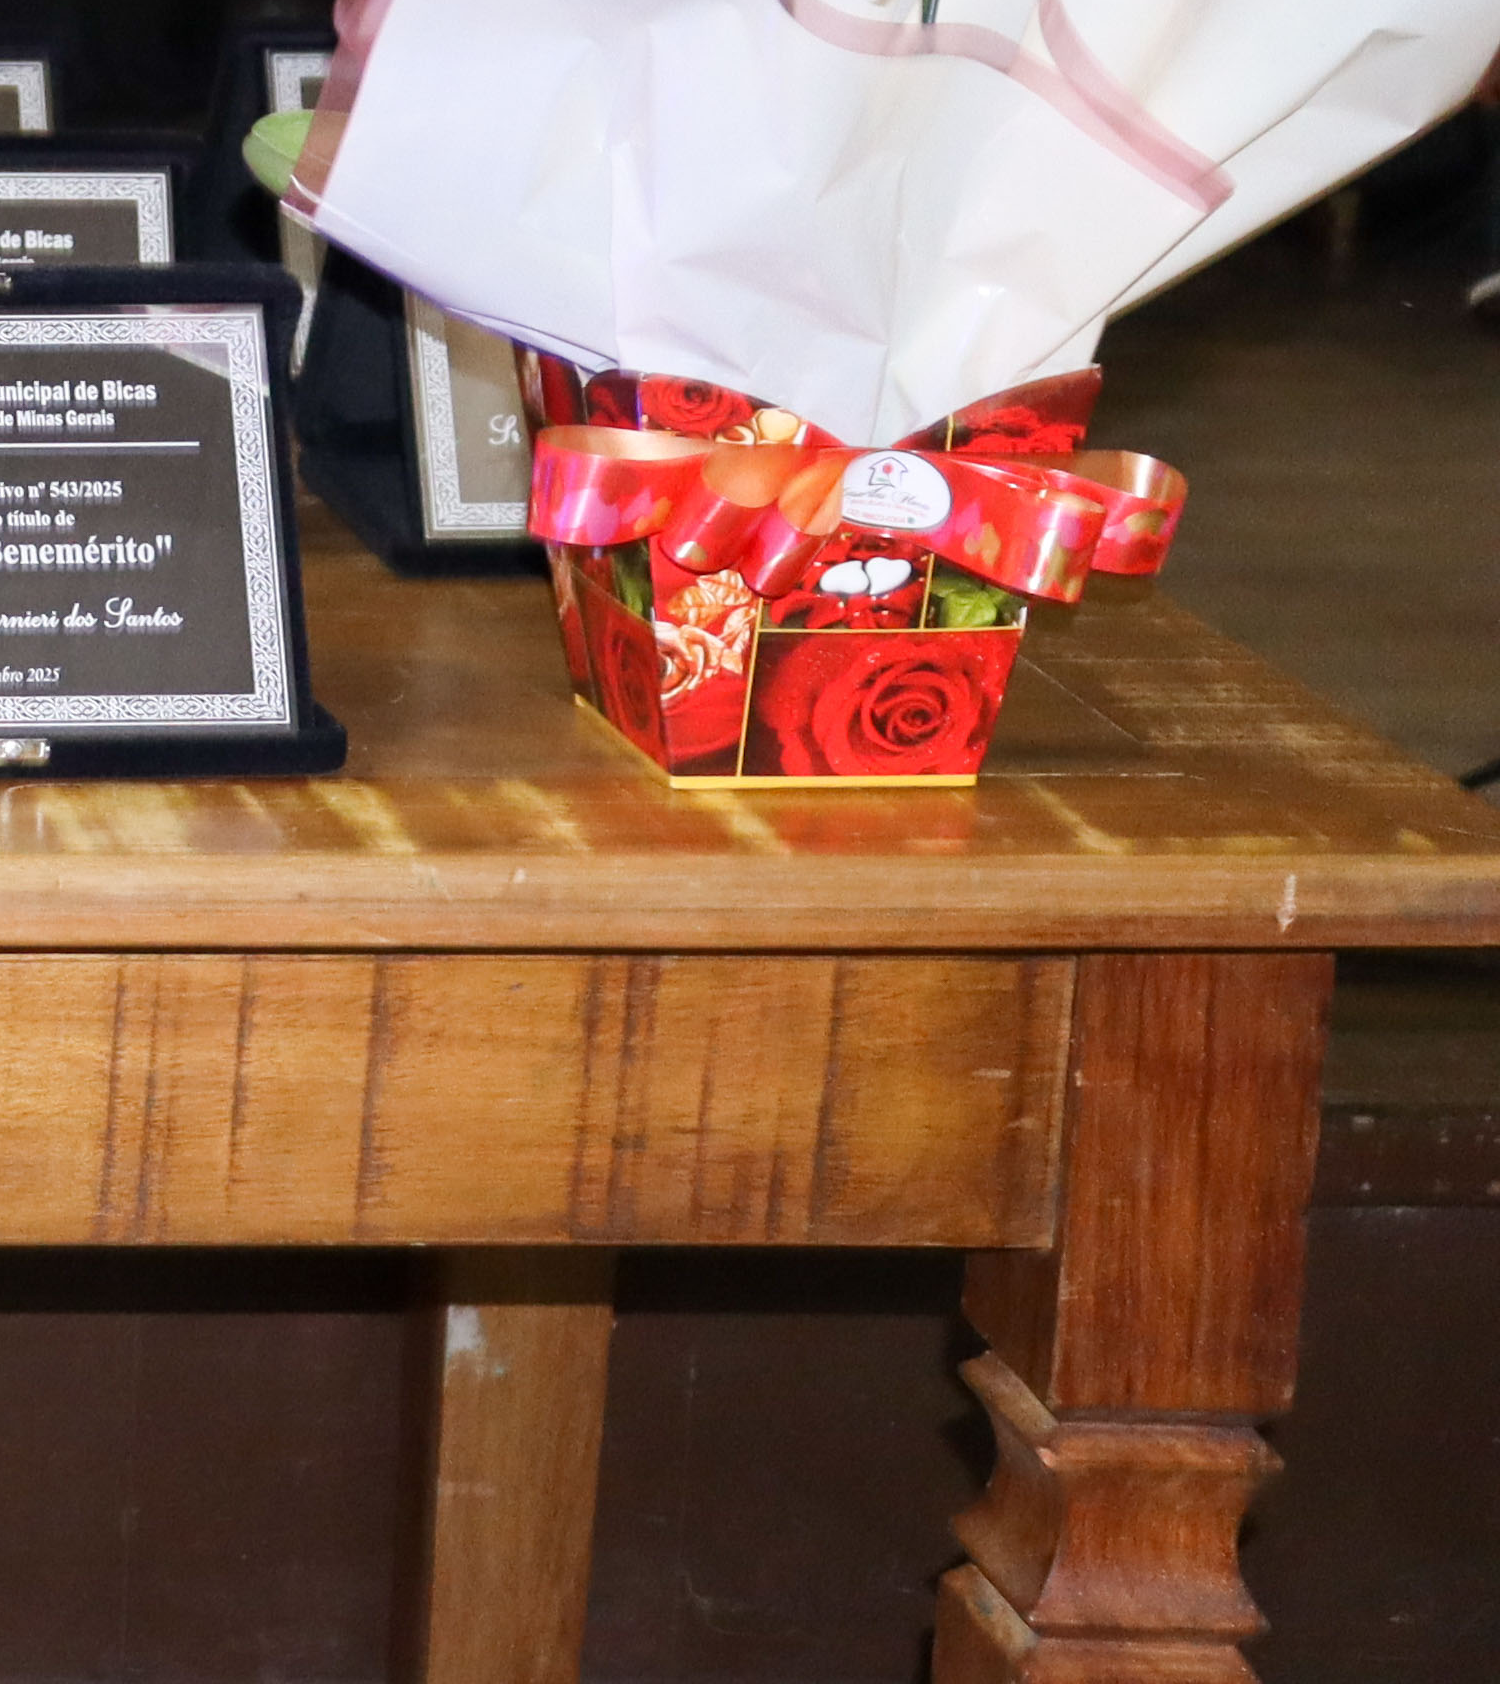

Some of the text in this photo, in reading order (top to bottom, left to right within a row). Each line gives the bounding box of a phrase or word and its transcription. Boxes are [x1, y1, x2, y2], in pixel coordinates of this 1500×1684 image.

[0, 230, 21, 248] de
[25, 230, 73, 248] Bicas
[74, 381, 98, 401] de
[103, 381, 156, 400] Bicas
[17, 411, 62, 427] Minas
[66, 410, 114, 426] Gerais
[50, 481, 122, 498] 543/2025
[8, 510, 51, 527] título
[55, 511, 75, 527] de
[63, 603, 97, 628] dos
[104, 597, 183, 628] Santos
[26, 668, 60, 683] 2025
